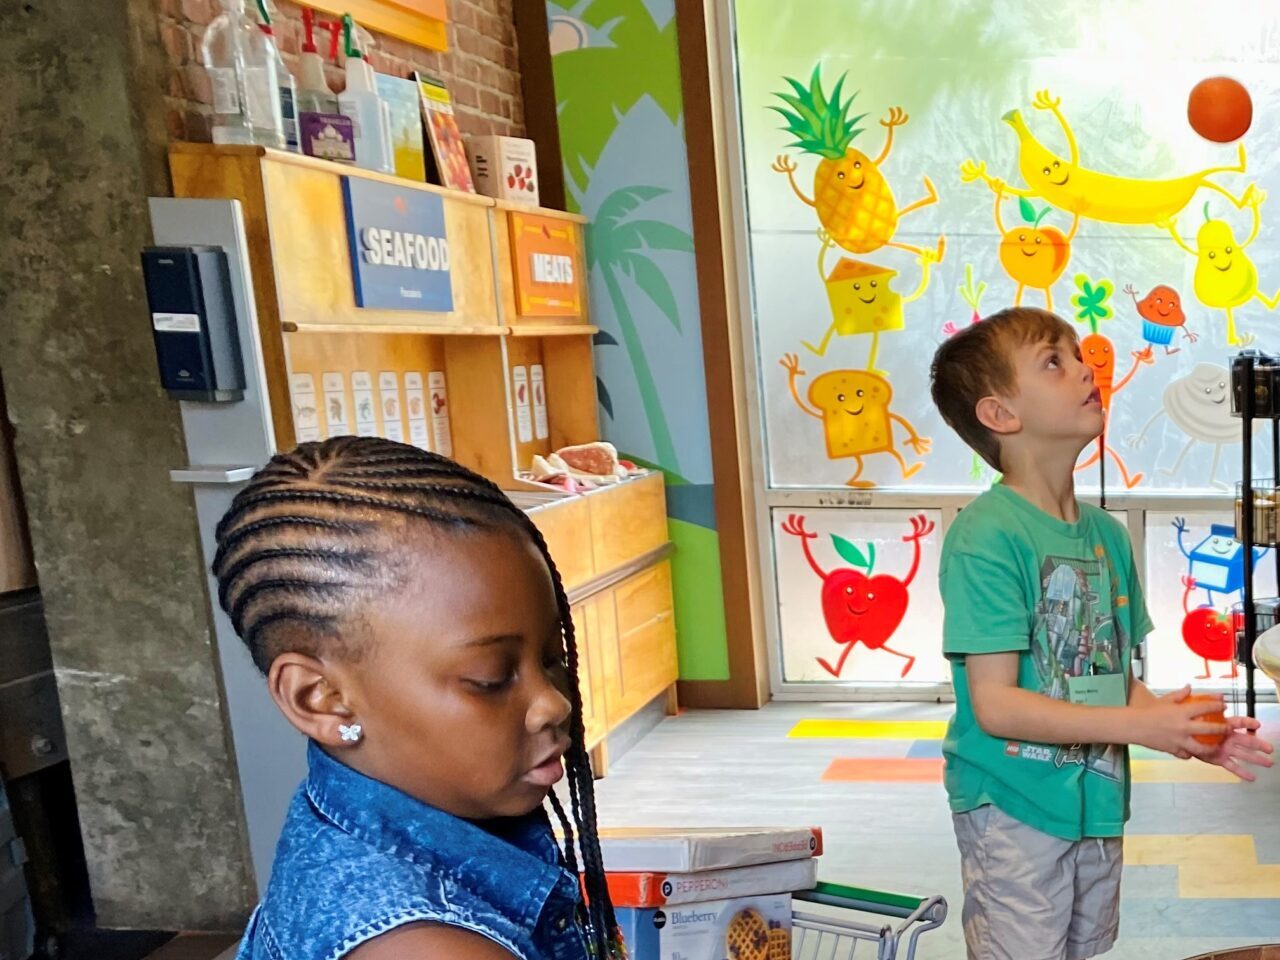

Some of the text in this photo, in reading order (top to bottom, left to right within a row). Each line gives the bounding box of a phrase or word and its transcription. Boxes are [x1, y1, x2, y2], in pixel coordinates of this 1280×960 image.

[367, 227, 449, 271] SEAFOOD
[533, 253, 573, 284] MEATS
[1023, 745, 1050, 754] STAR
[676, 878, 728, 893] PEPPERONI
[671, 910, 719, 925] Blueberry
